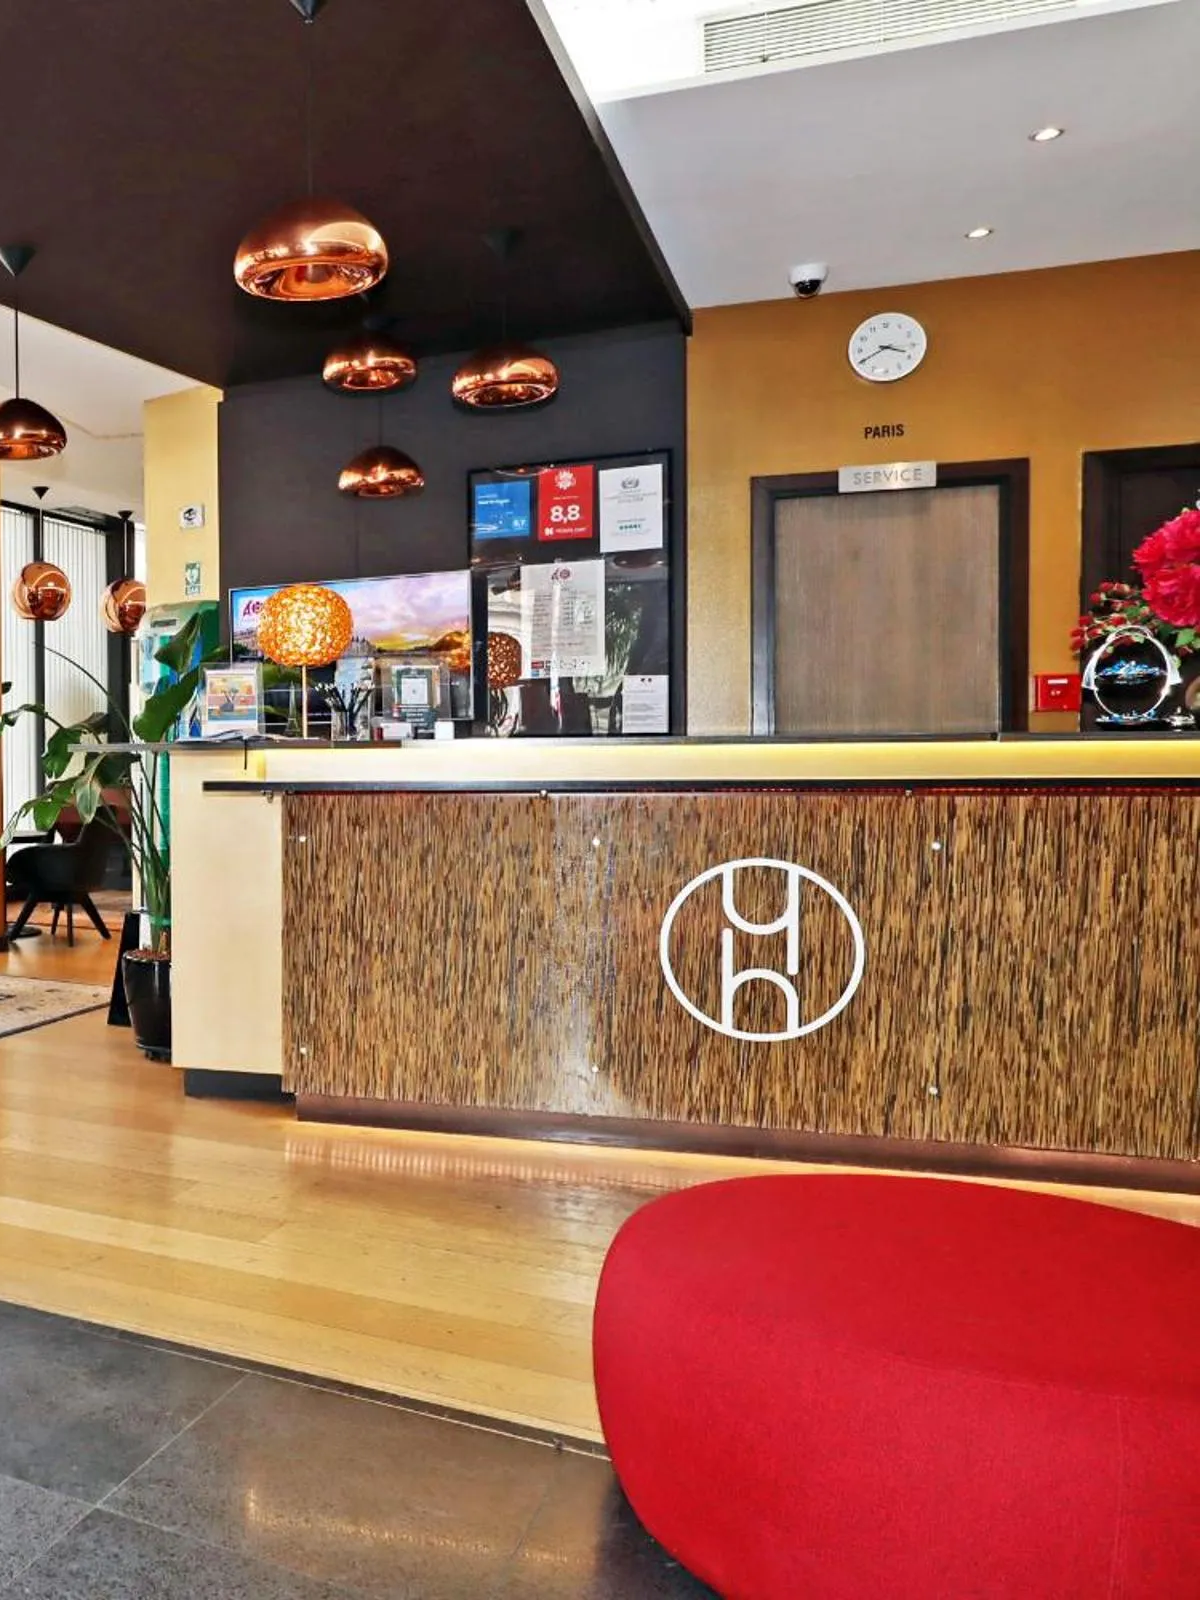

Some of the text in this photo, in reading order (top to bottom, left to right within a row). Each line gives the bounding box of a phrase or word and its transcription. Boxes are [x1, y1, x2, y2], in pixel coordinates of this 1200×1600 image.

[864, 424, 905, 439] PARIS
[853, 468, 923, 486] SERVICE
[550, 504, 580, 524] 8,8
